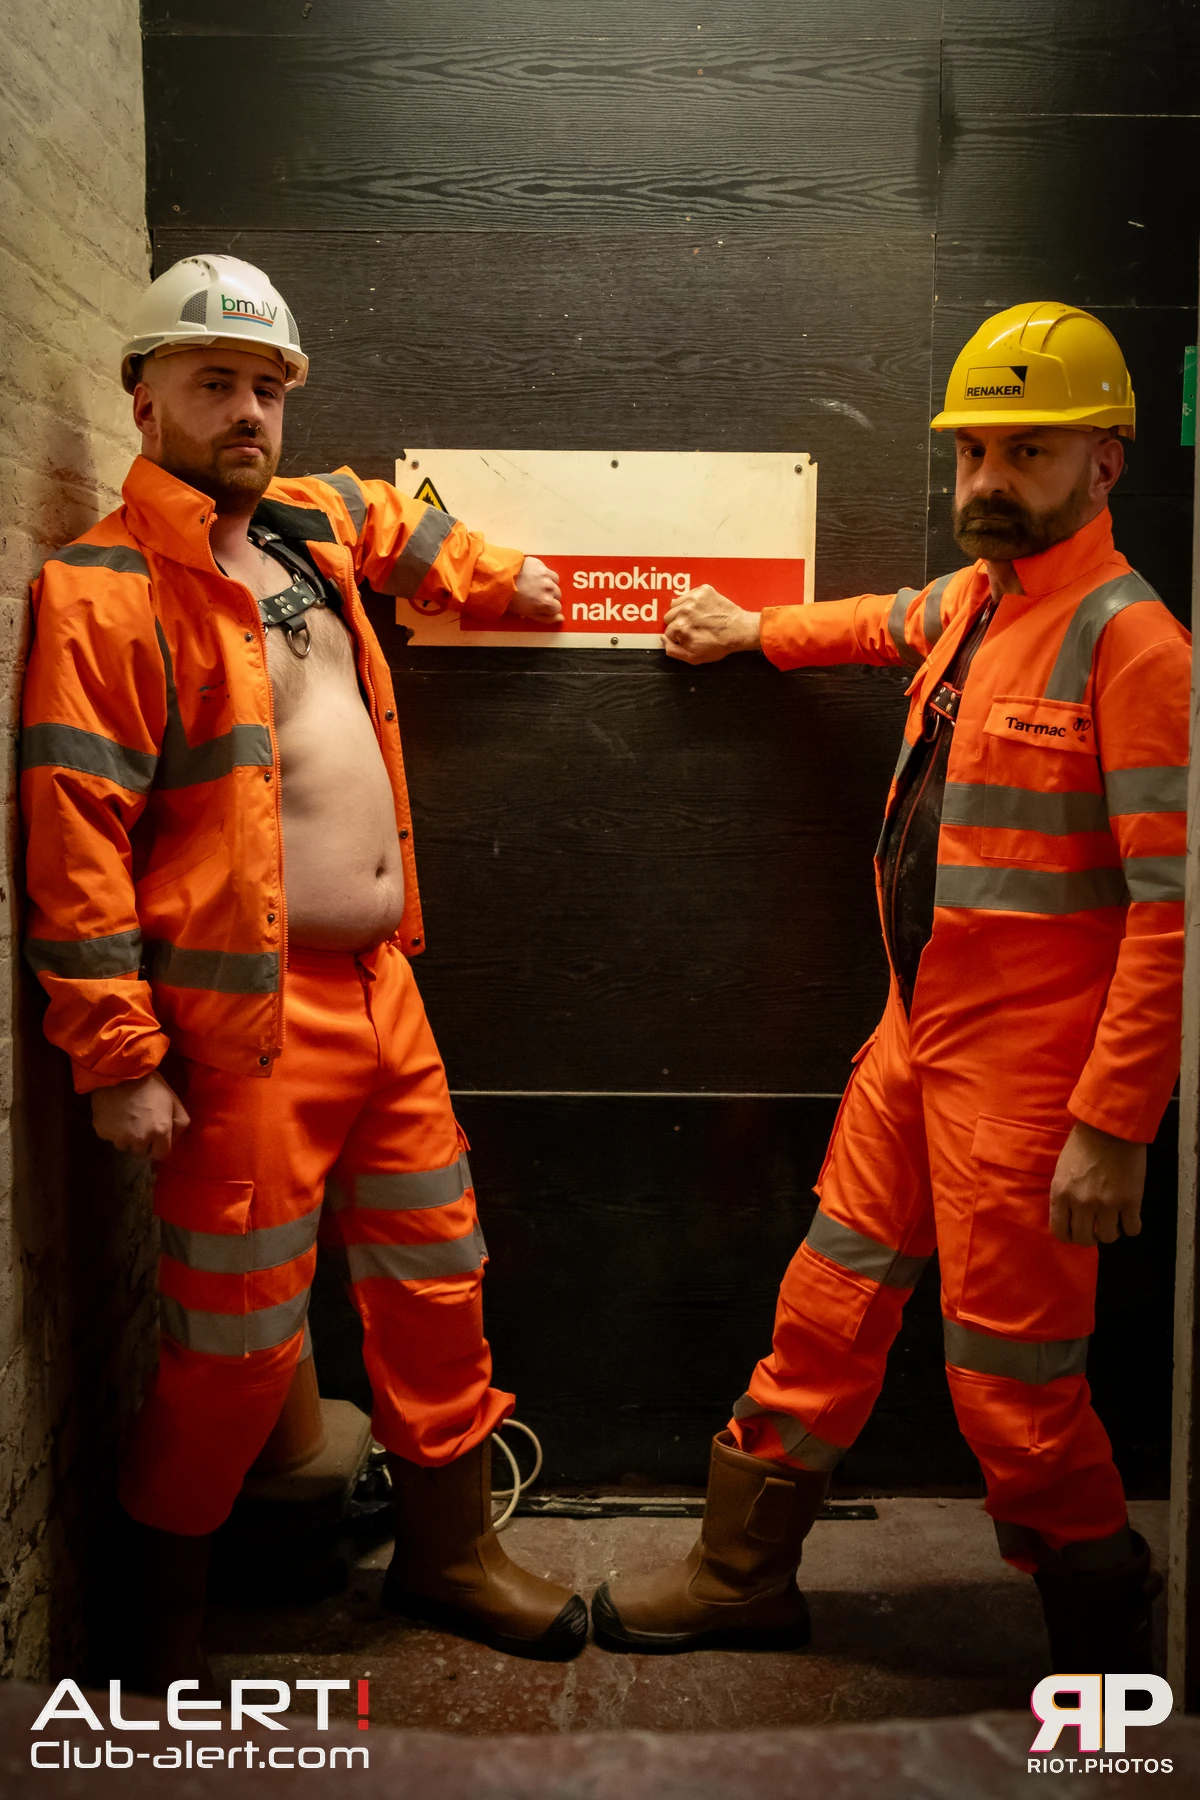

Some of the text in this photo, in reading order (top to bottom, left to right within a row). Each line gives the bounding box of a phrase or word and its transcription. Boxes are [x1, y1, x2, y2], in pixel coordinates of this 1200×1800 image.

[221, 294, 278, 320] bmJV
[966, 385, 1022, 397] RENAKER
[572, 566, 691, 596] smoking
[571, 597, 658, 622] naked
[1005, 716, 1067, 738] Tarmac
